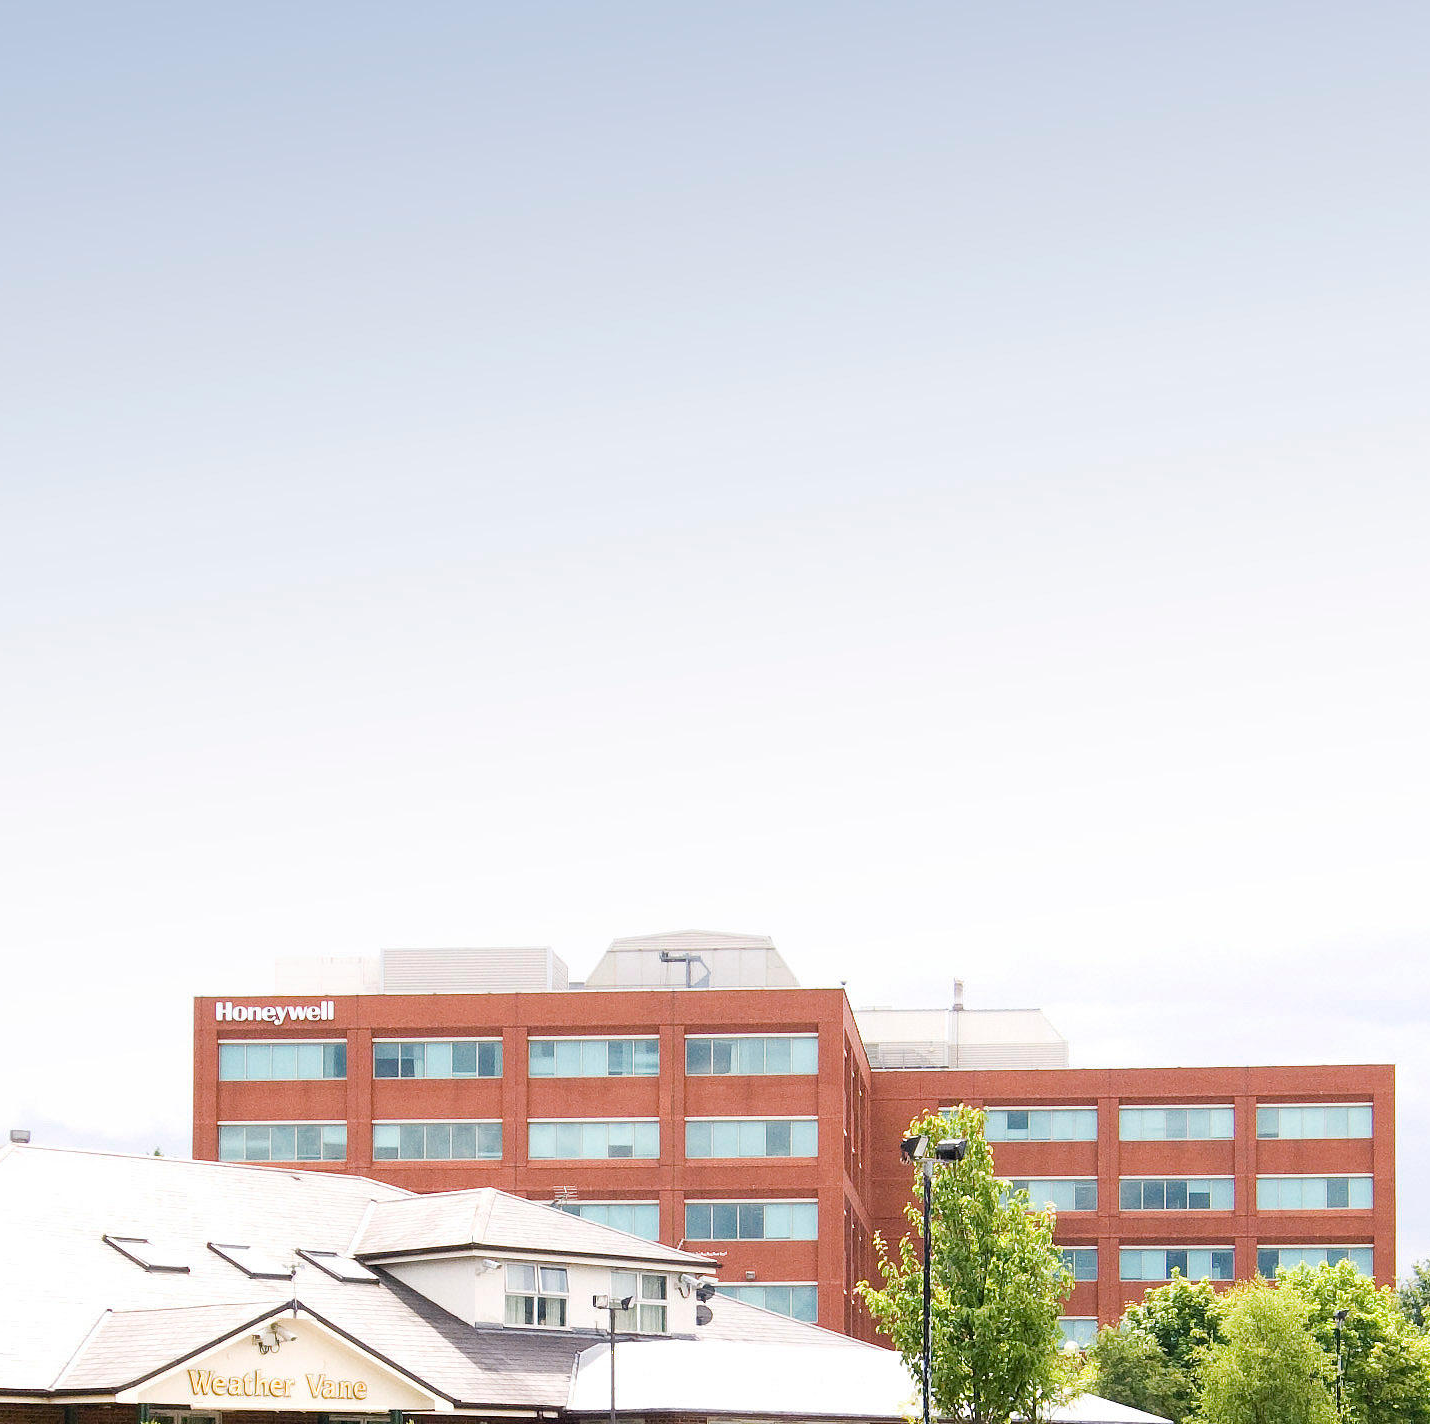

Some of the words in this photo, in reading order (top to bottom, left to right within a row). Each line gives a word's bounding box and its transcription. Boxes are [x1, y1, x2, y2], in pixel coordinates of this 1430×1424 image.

[215, 1000, 335, 1026] Honeywell
[187, 1369, 295, 1397] Weather
[305, 1373, 368, 1400] Vane
